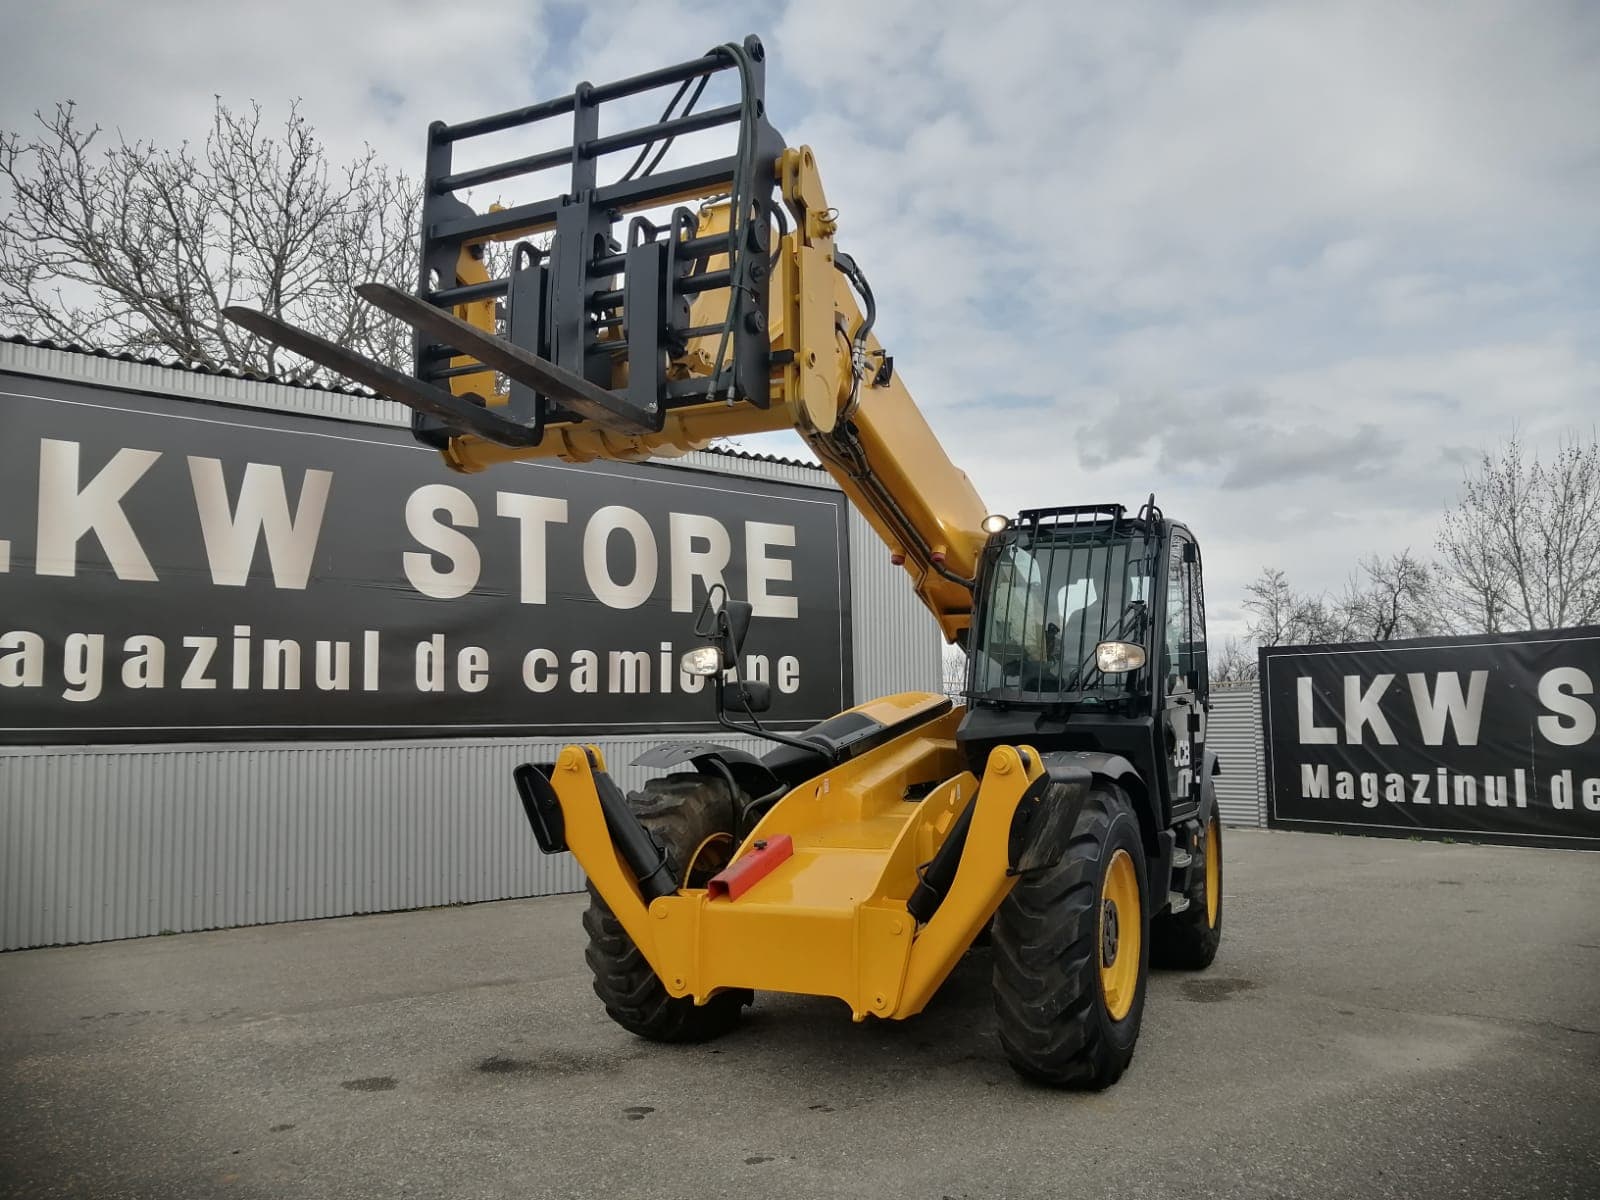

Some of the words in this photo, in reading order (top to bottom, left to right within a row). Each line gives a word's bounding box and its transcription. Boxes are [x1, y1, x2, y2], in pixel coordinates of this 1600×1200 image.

[0, 438, 334, 590] KW
[403, 484, 799, 619] STORE
[415, 633, 489, 693] de
[1297, 670, 1489, 746] LKW
[1301, 763, 1528, 808] Magazinul
[1551, 769, 1600, 811] de
